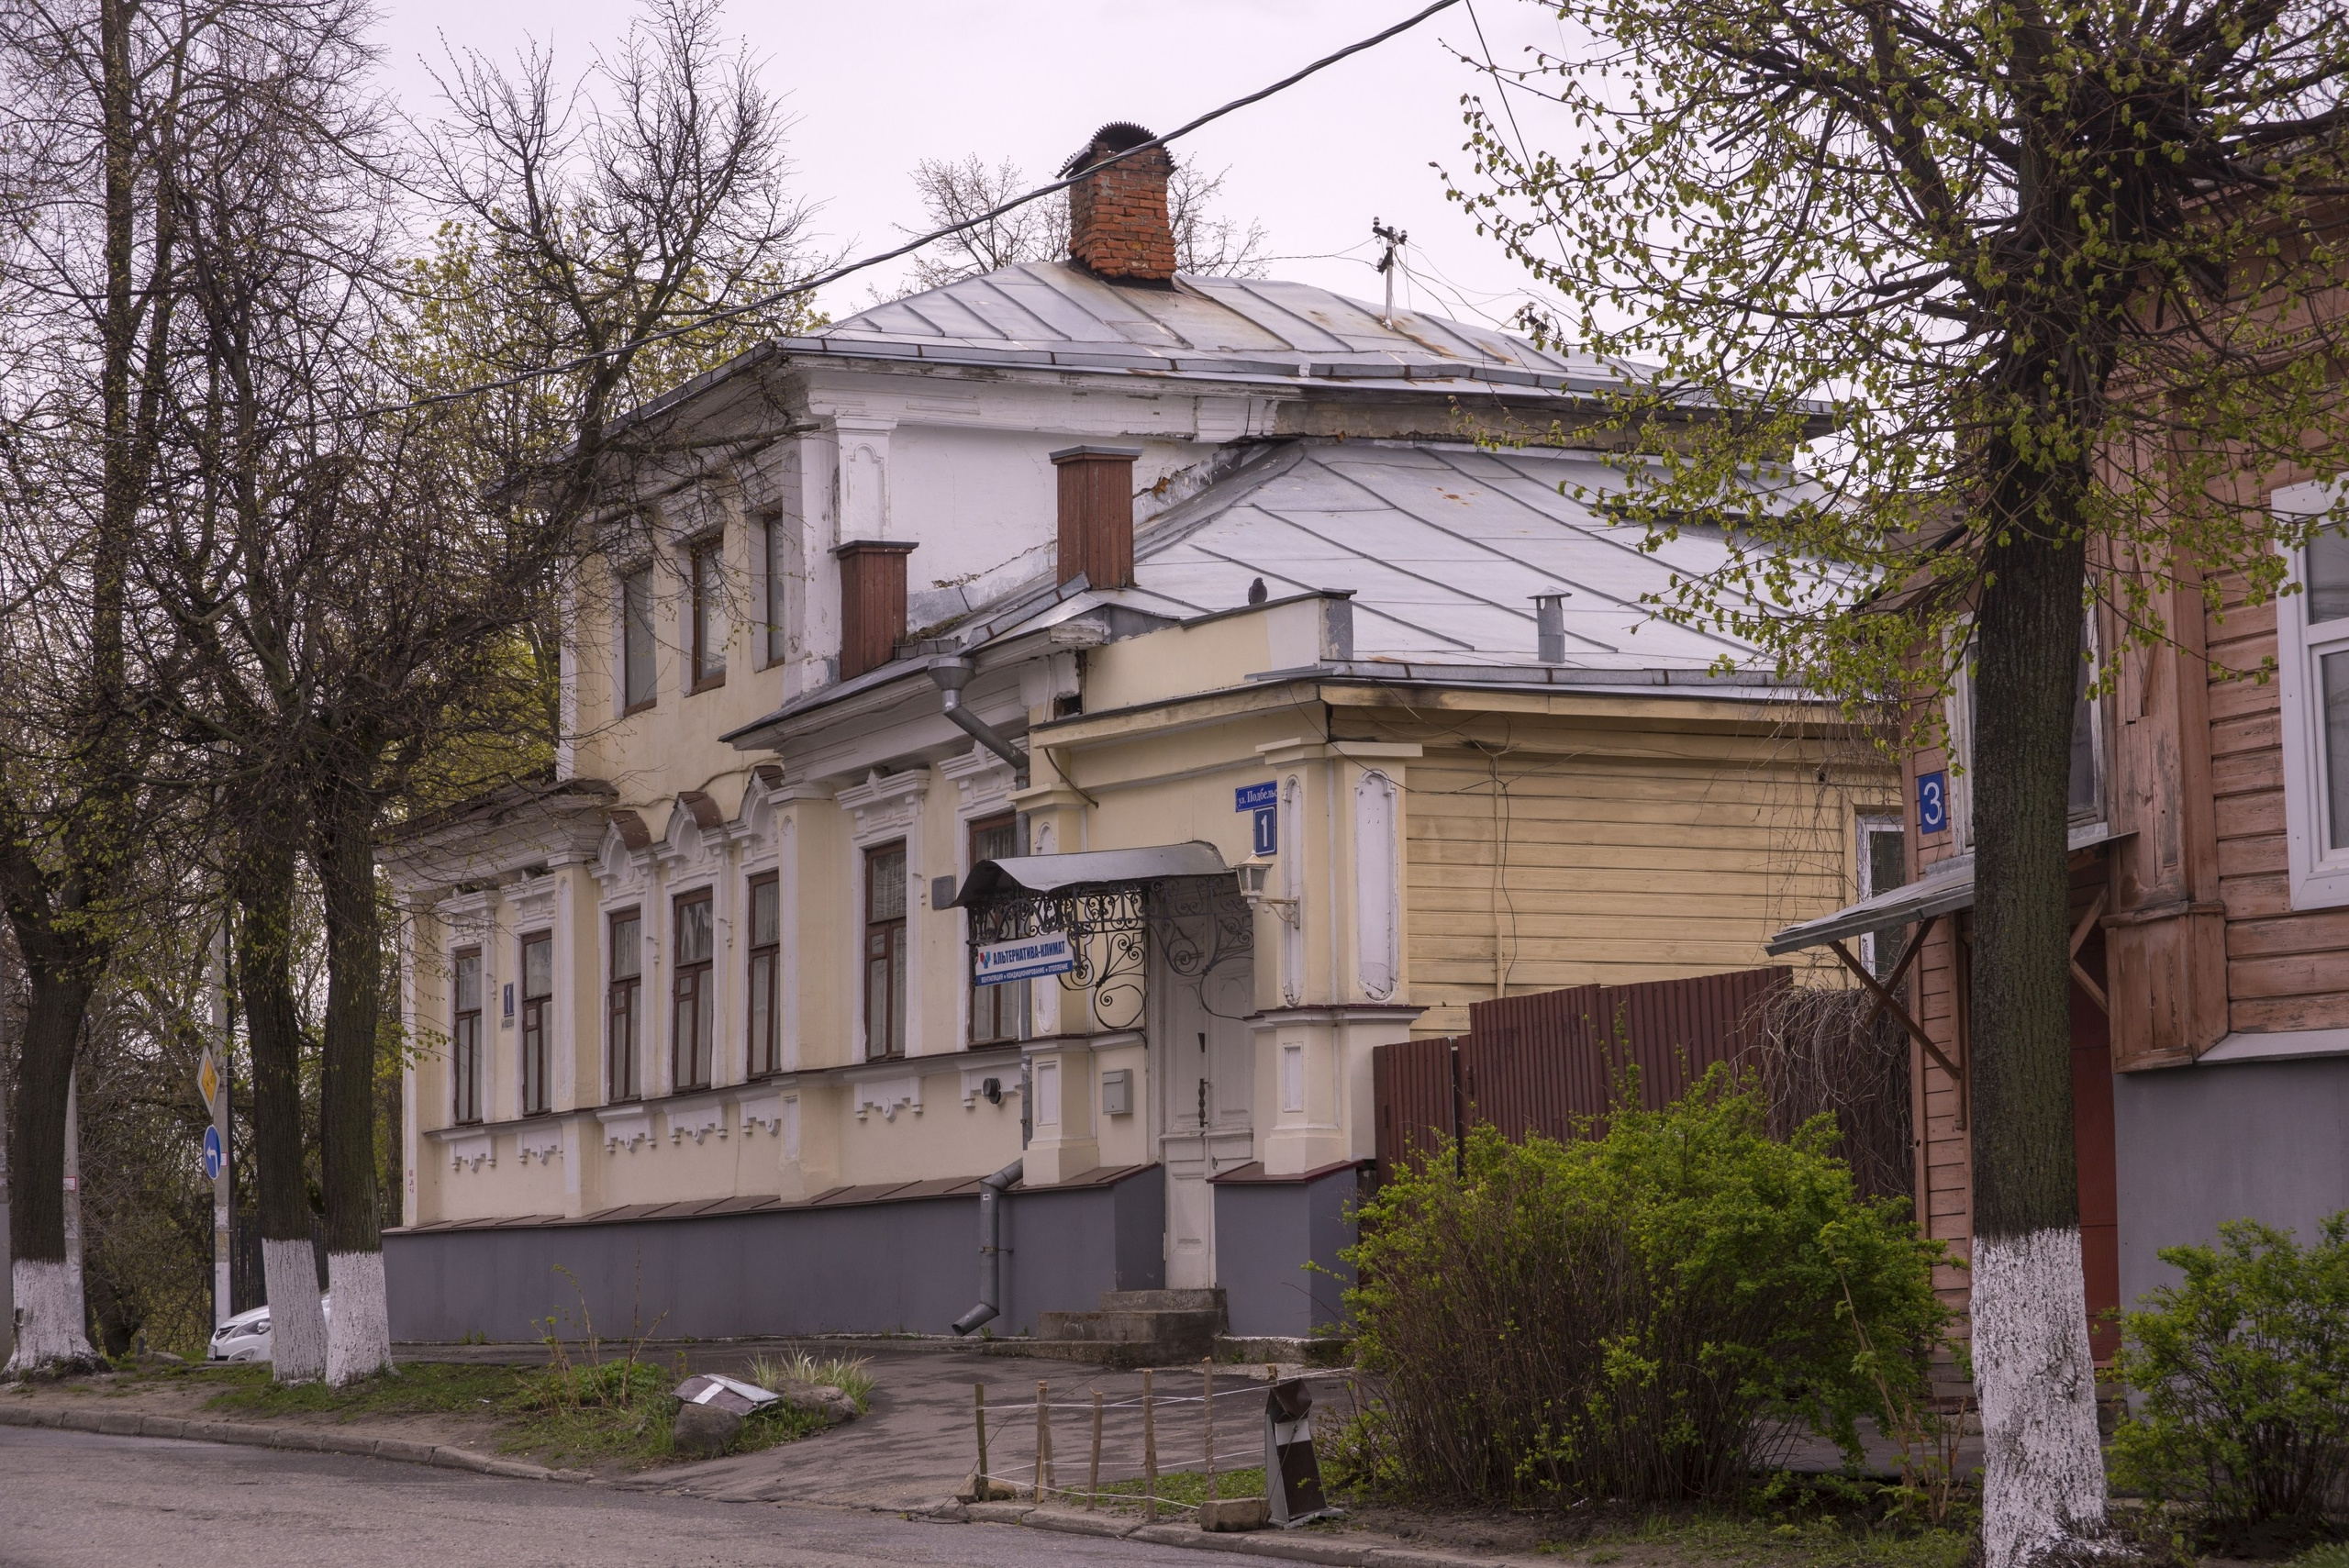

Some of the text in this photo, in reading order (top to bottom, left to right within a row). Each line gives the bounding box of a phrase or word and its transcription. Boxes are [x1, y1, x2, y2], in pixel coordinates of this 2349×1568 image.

[1923, 782, 1943, 825] 3
[1261, 814, 1268, 848] 1
[993, 940, 1065, 965] АЛЬТЕРНАТИВА-КЛИМАТ
[506, 985, 510, 1014] 1
